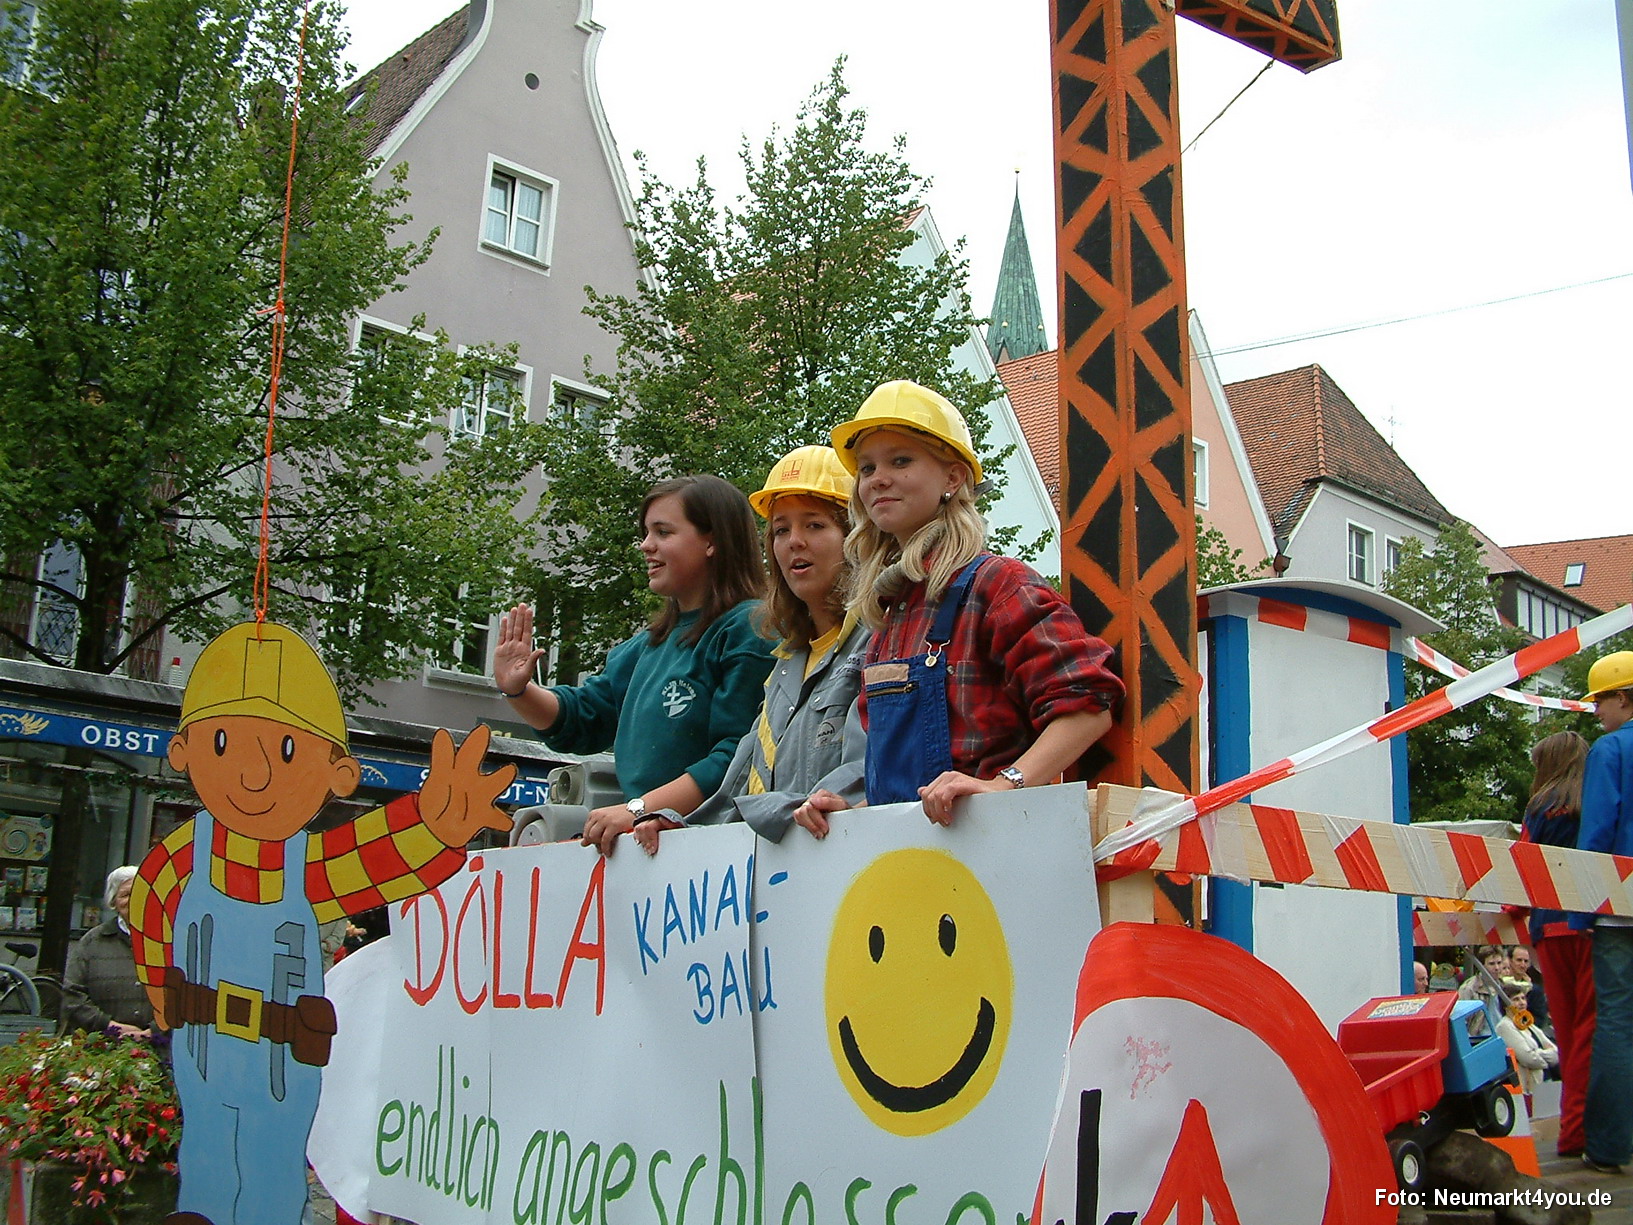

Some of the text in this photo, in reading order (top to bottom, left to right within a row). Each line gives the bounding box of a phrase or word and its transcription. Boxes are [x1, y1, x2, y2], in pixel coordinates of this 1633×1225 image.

[81, 725, 159, 753] OBST
[633, 853, 788, 976] KANAL-
[686, 946, 778, 1025] BAU
[375, 1044, 500, 1213] endlich
